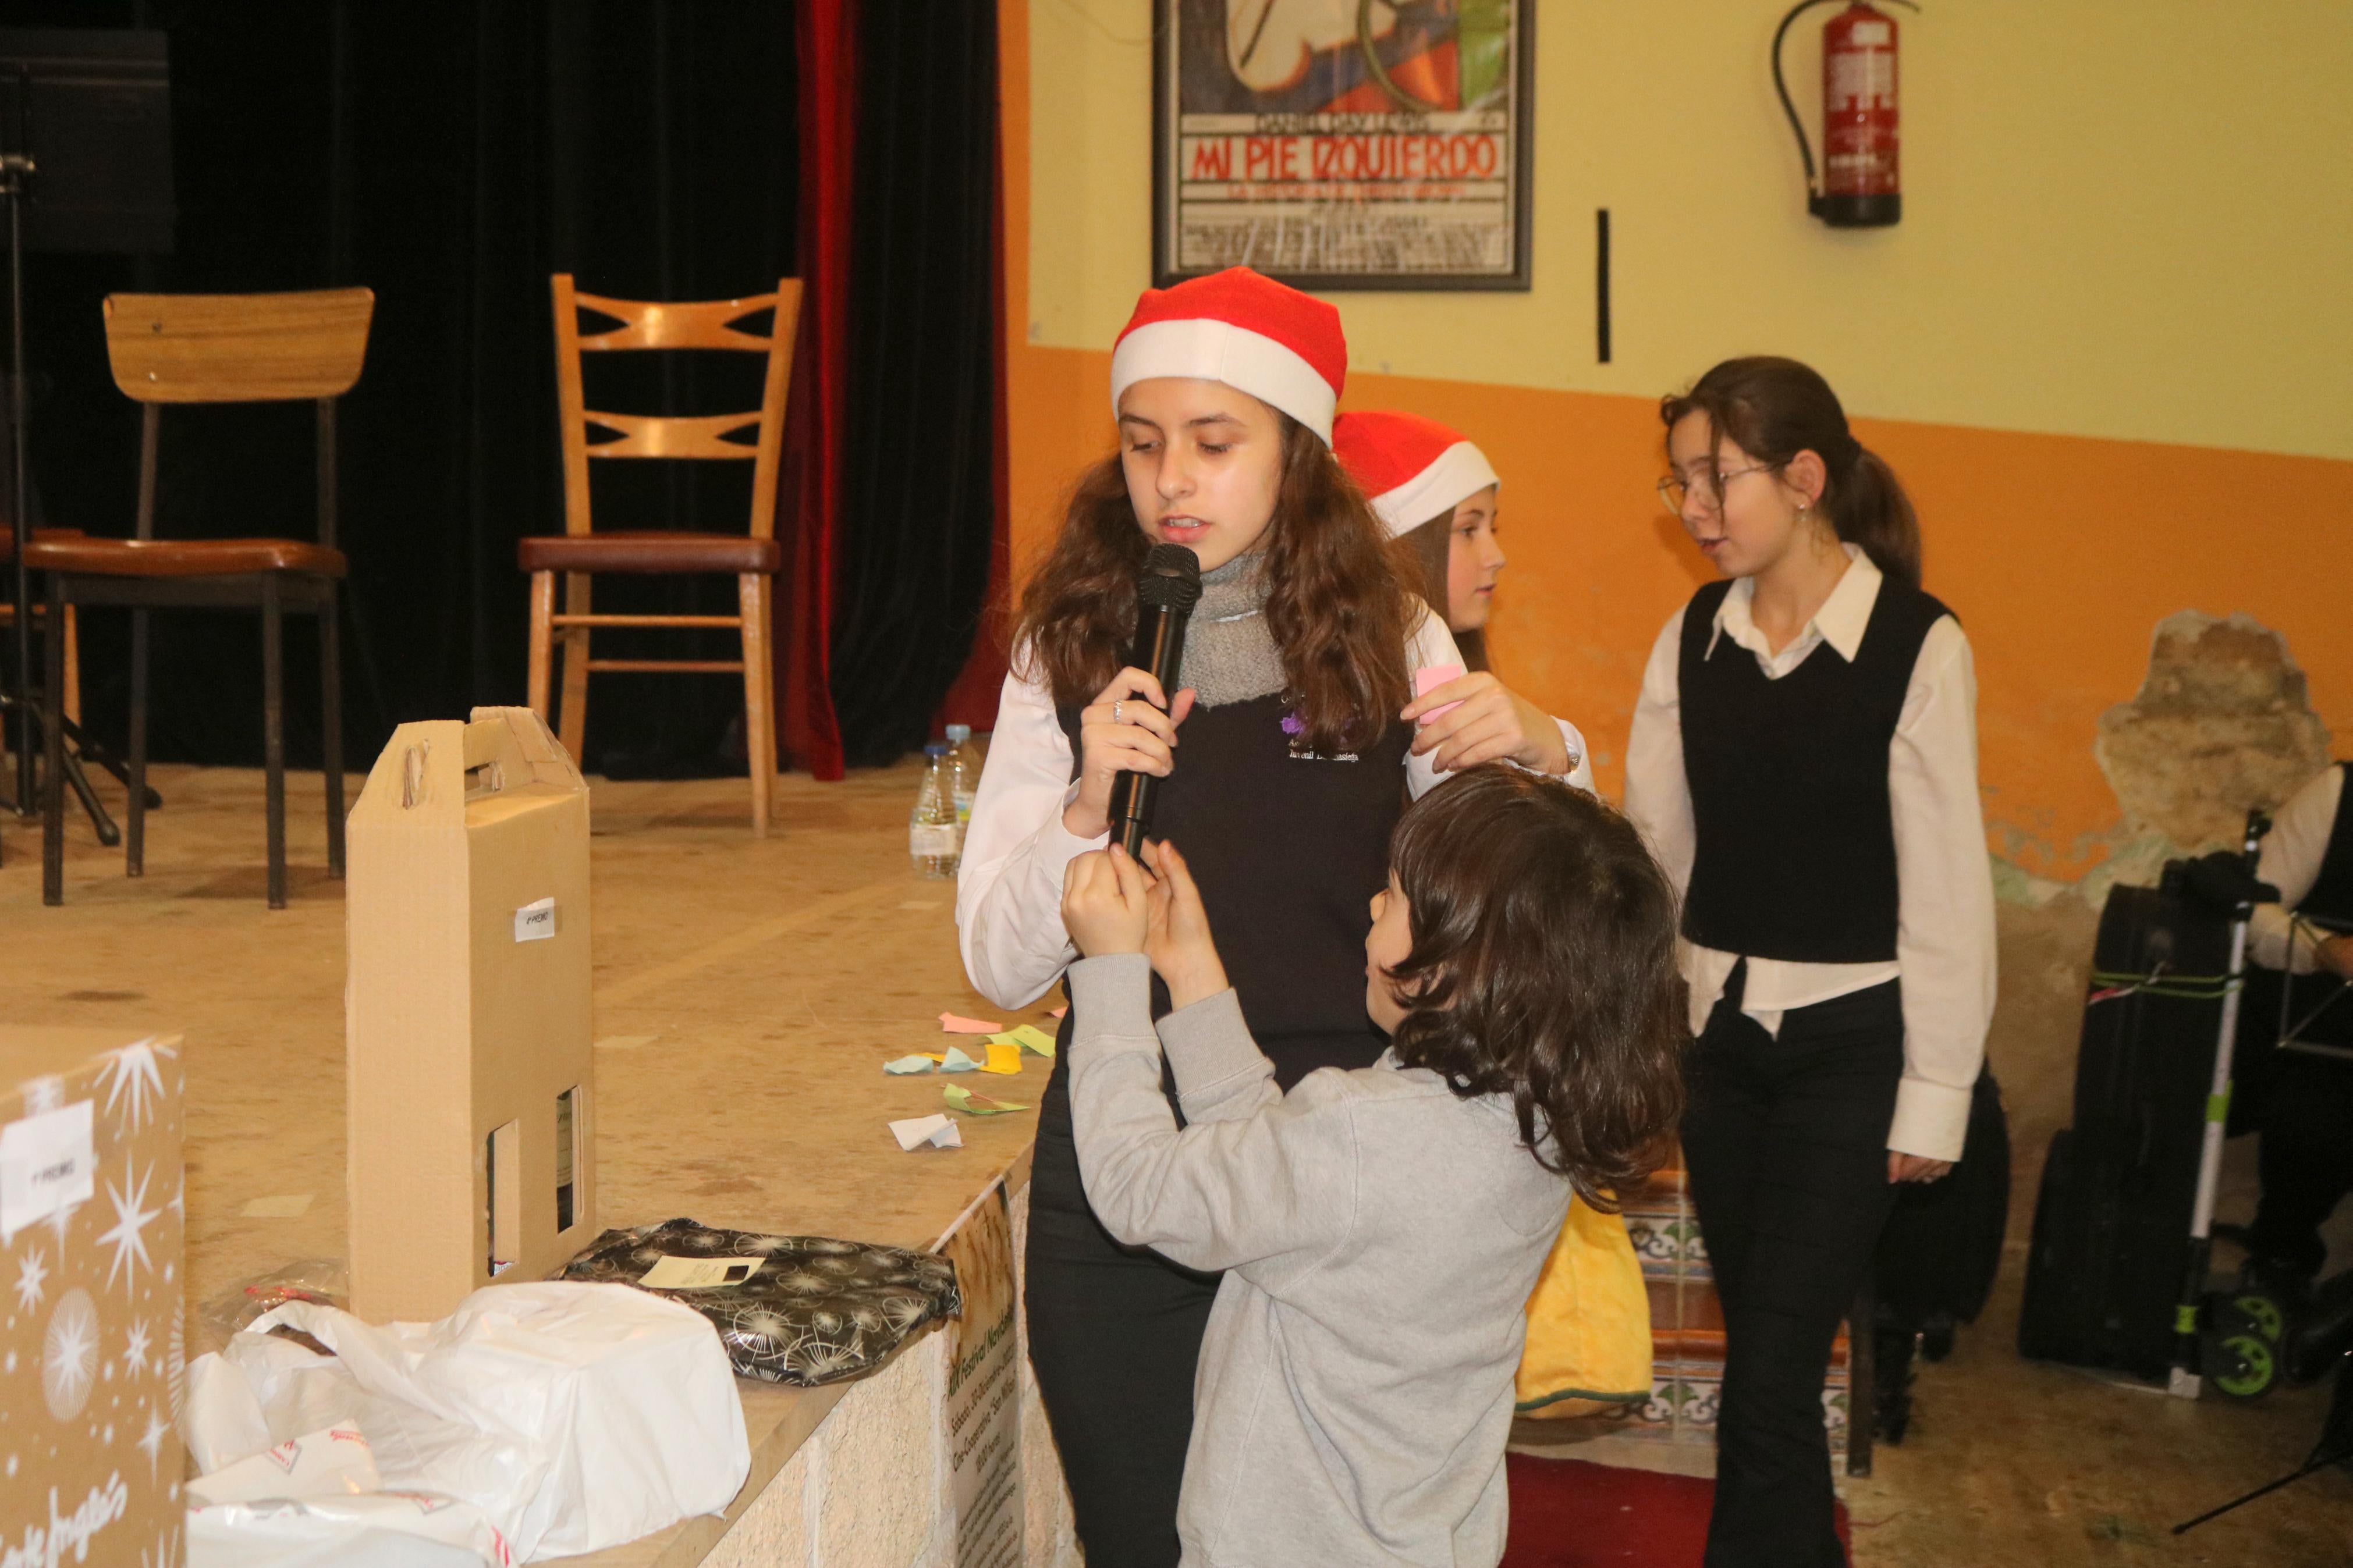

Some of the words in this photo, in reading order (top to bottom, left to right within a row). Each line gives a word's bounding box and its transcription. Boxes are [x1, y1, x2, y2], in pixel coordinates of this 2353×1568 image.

[1191, 136, 1232, 180] MI
[1244, 135, 1298, 180] PIE
[1311, 133, 1497, 179] IZQUIERDO
[961, 1331, 986, 1385] Festival
